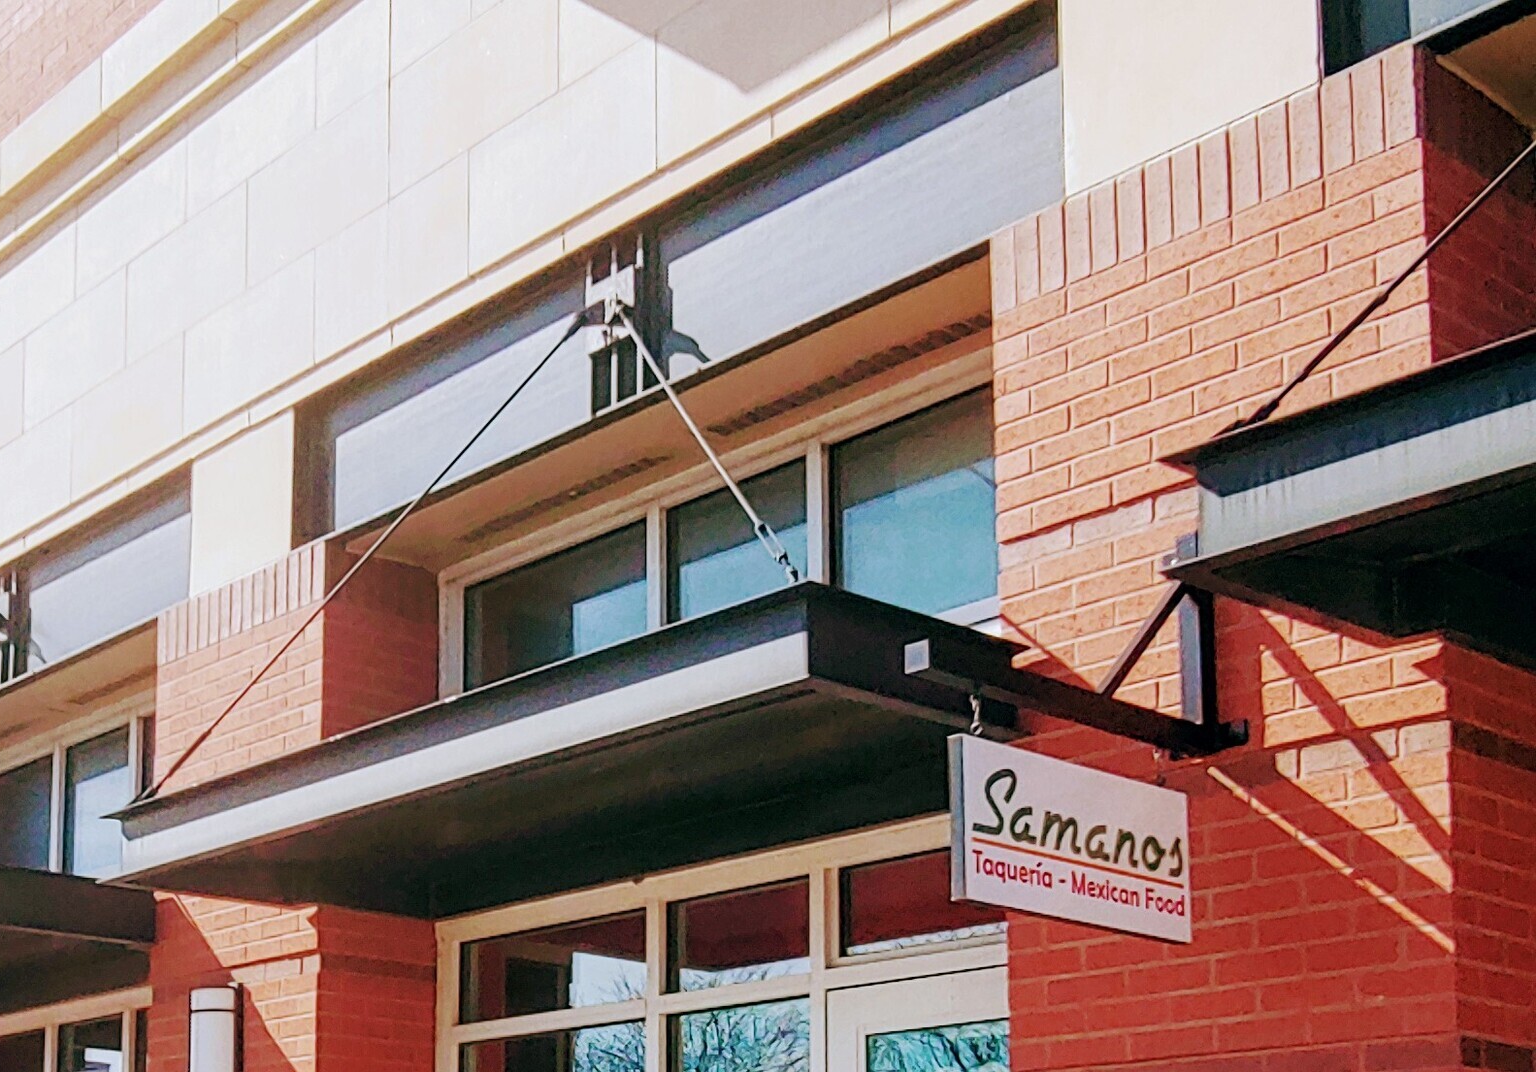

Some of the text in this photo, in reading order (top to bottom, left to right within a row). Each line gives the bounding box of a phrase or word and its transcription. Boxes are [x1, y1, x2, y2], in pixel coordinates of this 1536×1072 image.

[972, 768, 1183, 877] Samanos
[972, 849, 1053, 888] Taquería
[1071, 870, 1140, 908] Mexican
[1145, 887, 1185, 917] Food
